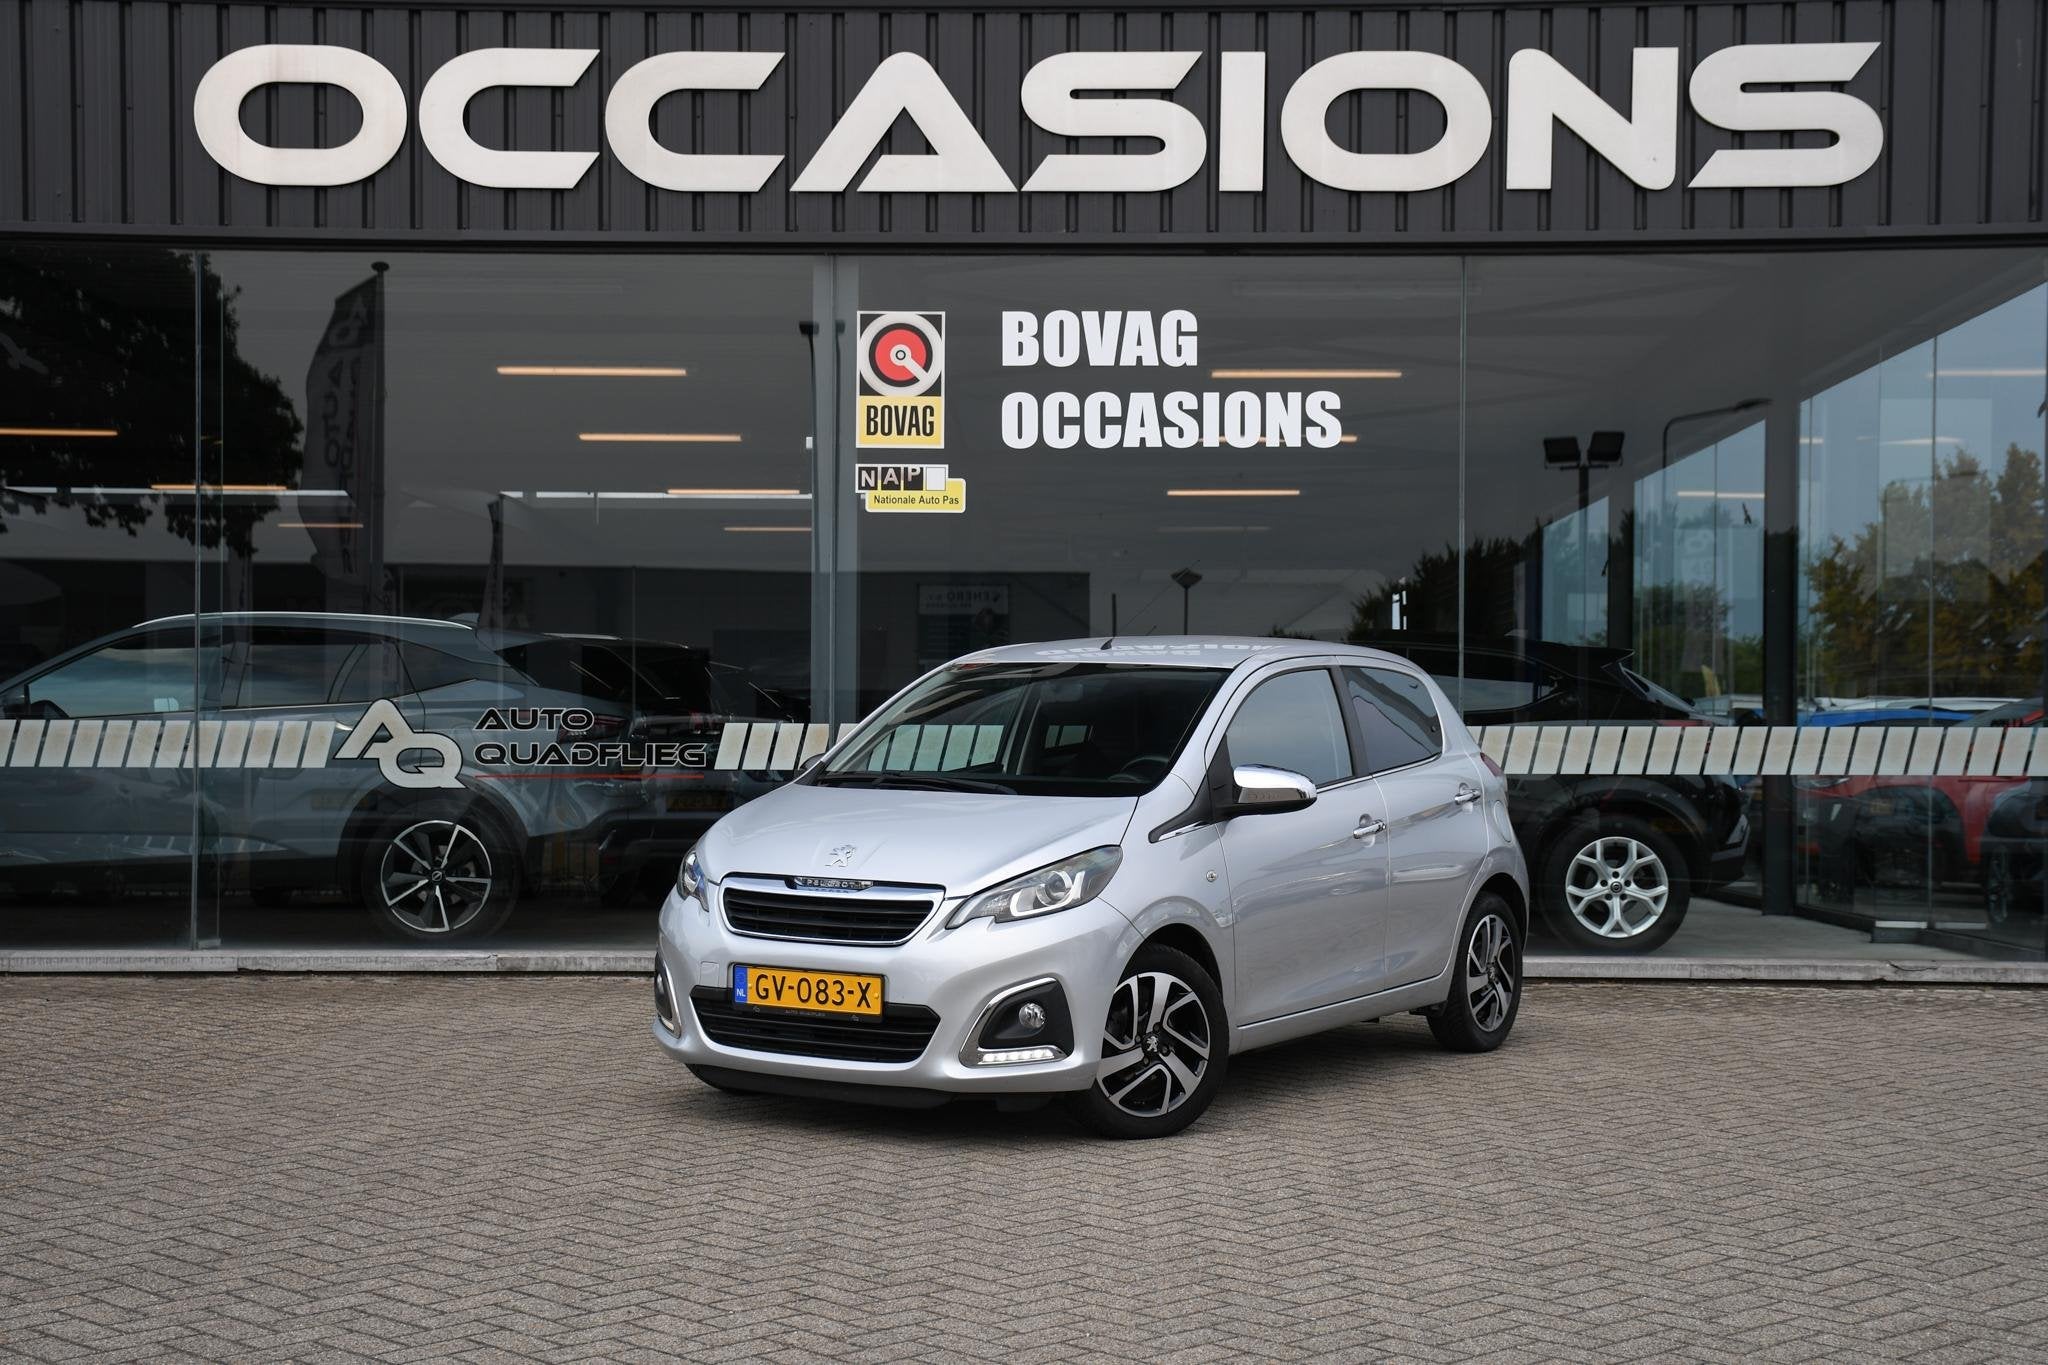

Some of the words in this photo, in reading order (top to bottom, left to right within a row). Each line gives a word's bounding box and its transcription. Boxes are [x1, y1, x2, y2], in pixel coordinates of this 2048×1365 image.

[193, 41, 1884, 194] OCCASIONS
[1002, 309, 1198, 367] BOVAG
[865, 403, 935, 438] BOVAG
[1002, 390, 1342, 449] OCCASIONS
[861, 465, 921, 487] NAP
[873, 495, 916, 505] Nationale
[918, 495, 940, 505] Auto
[942, 496, 960, 505] Pas
[474, 707, 595, 732] AUTO
[334, 699, 467, 789] AQ
[474, 741, 708, 768] QUADFLIEG
[736, 988, 746, 998] NL
[755, 973, 872, 1009] GV-083-X
